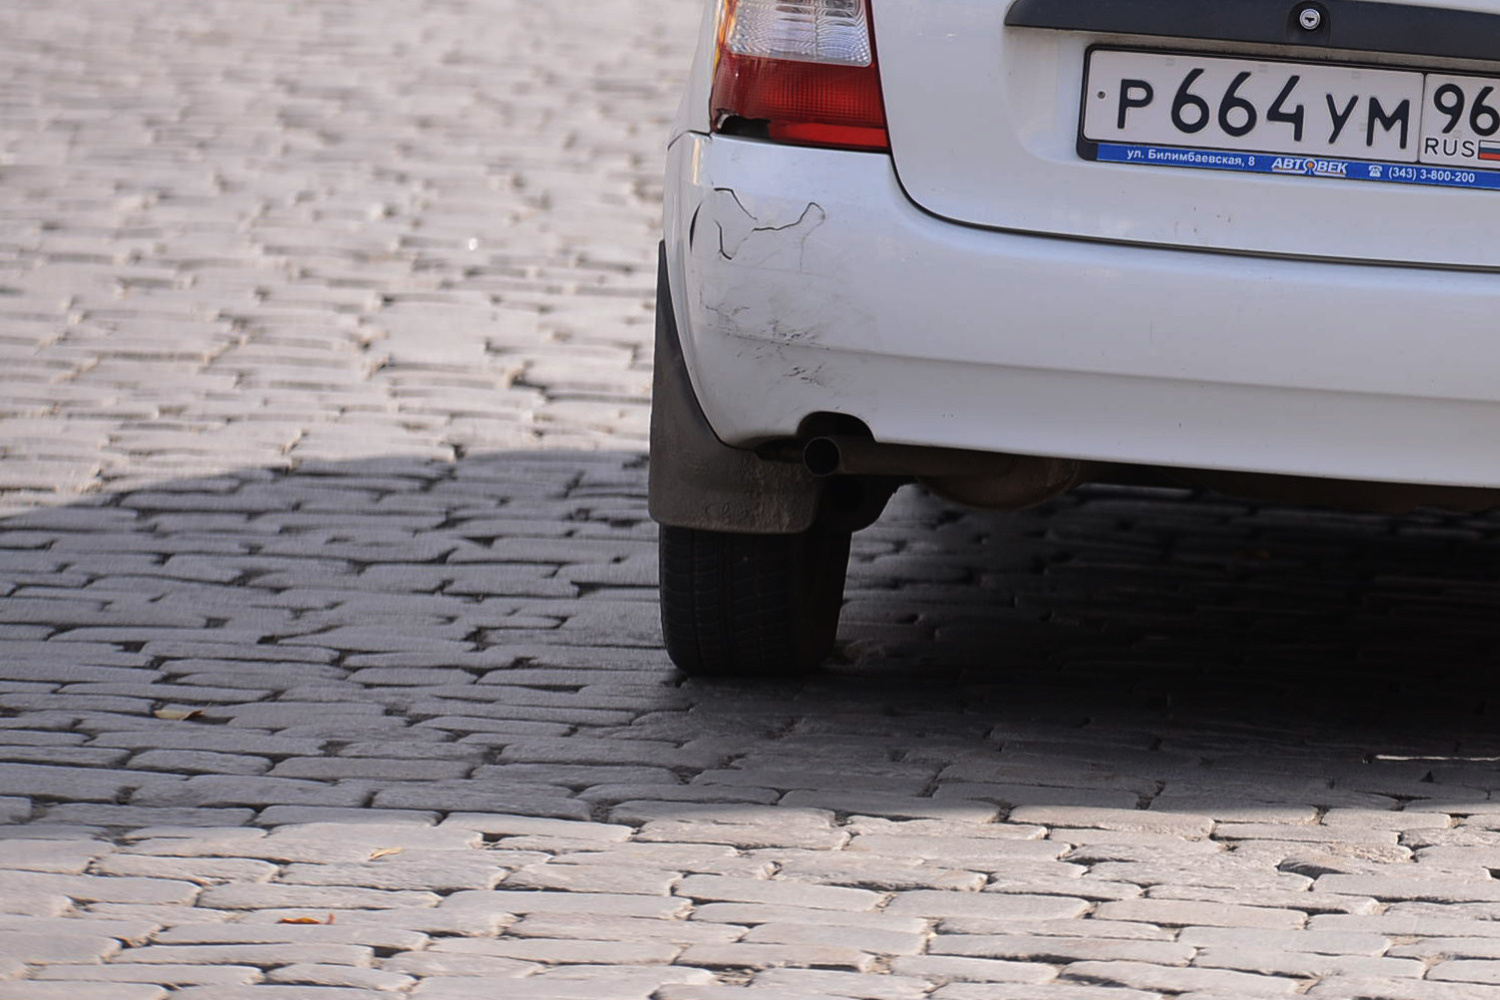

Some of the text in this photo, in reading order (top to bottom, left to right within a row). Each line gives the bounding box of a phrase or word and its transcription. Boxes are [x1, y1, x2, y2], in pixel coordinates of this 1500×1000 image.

[1433, 83, 1500, 136] 96
[1424, 138, 1475, 158] RUS
[1126, 149, 1255, 167] ул. Билимбаевская, 8
[1388, 167, 1475, 183] (343) 3-800-200
